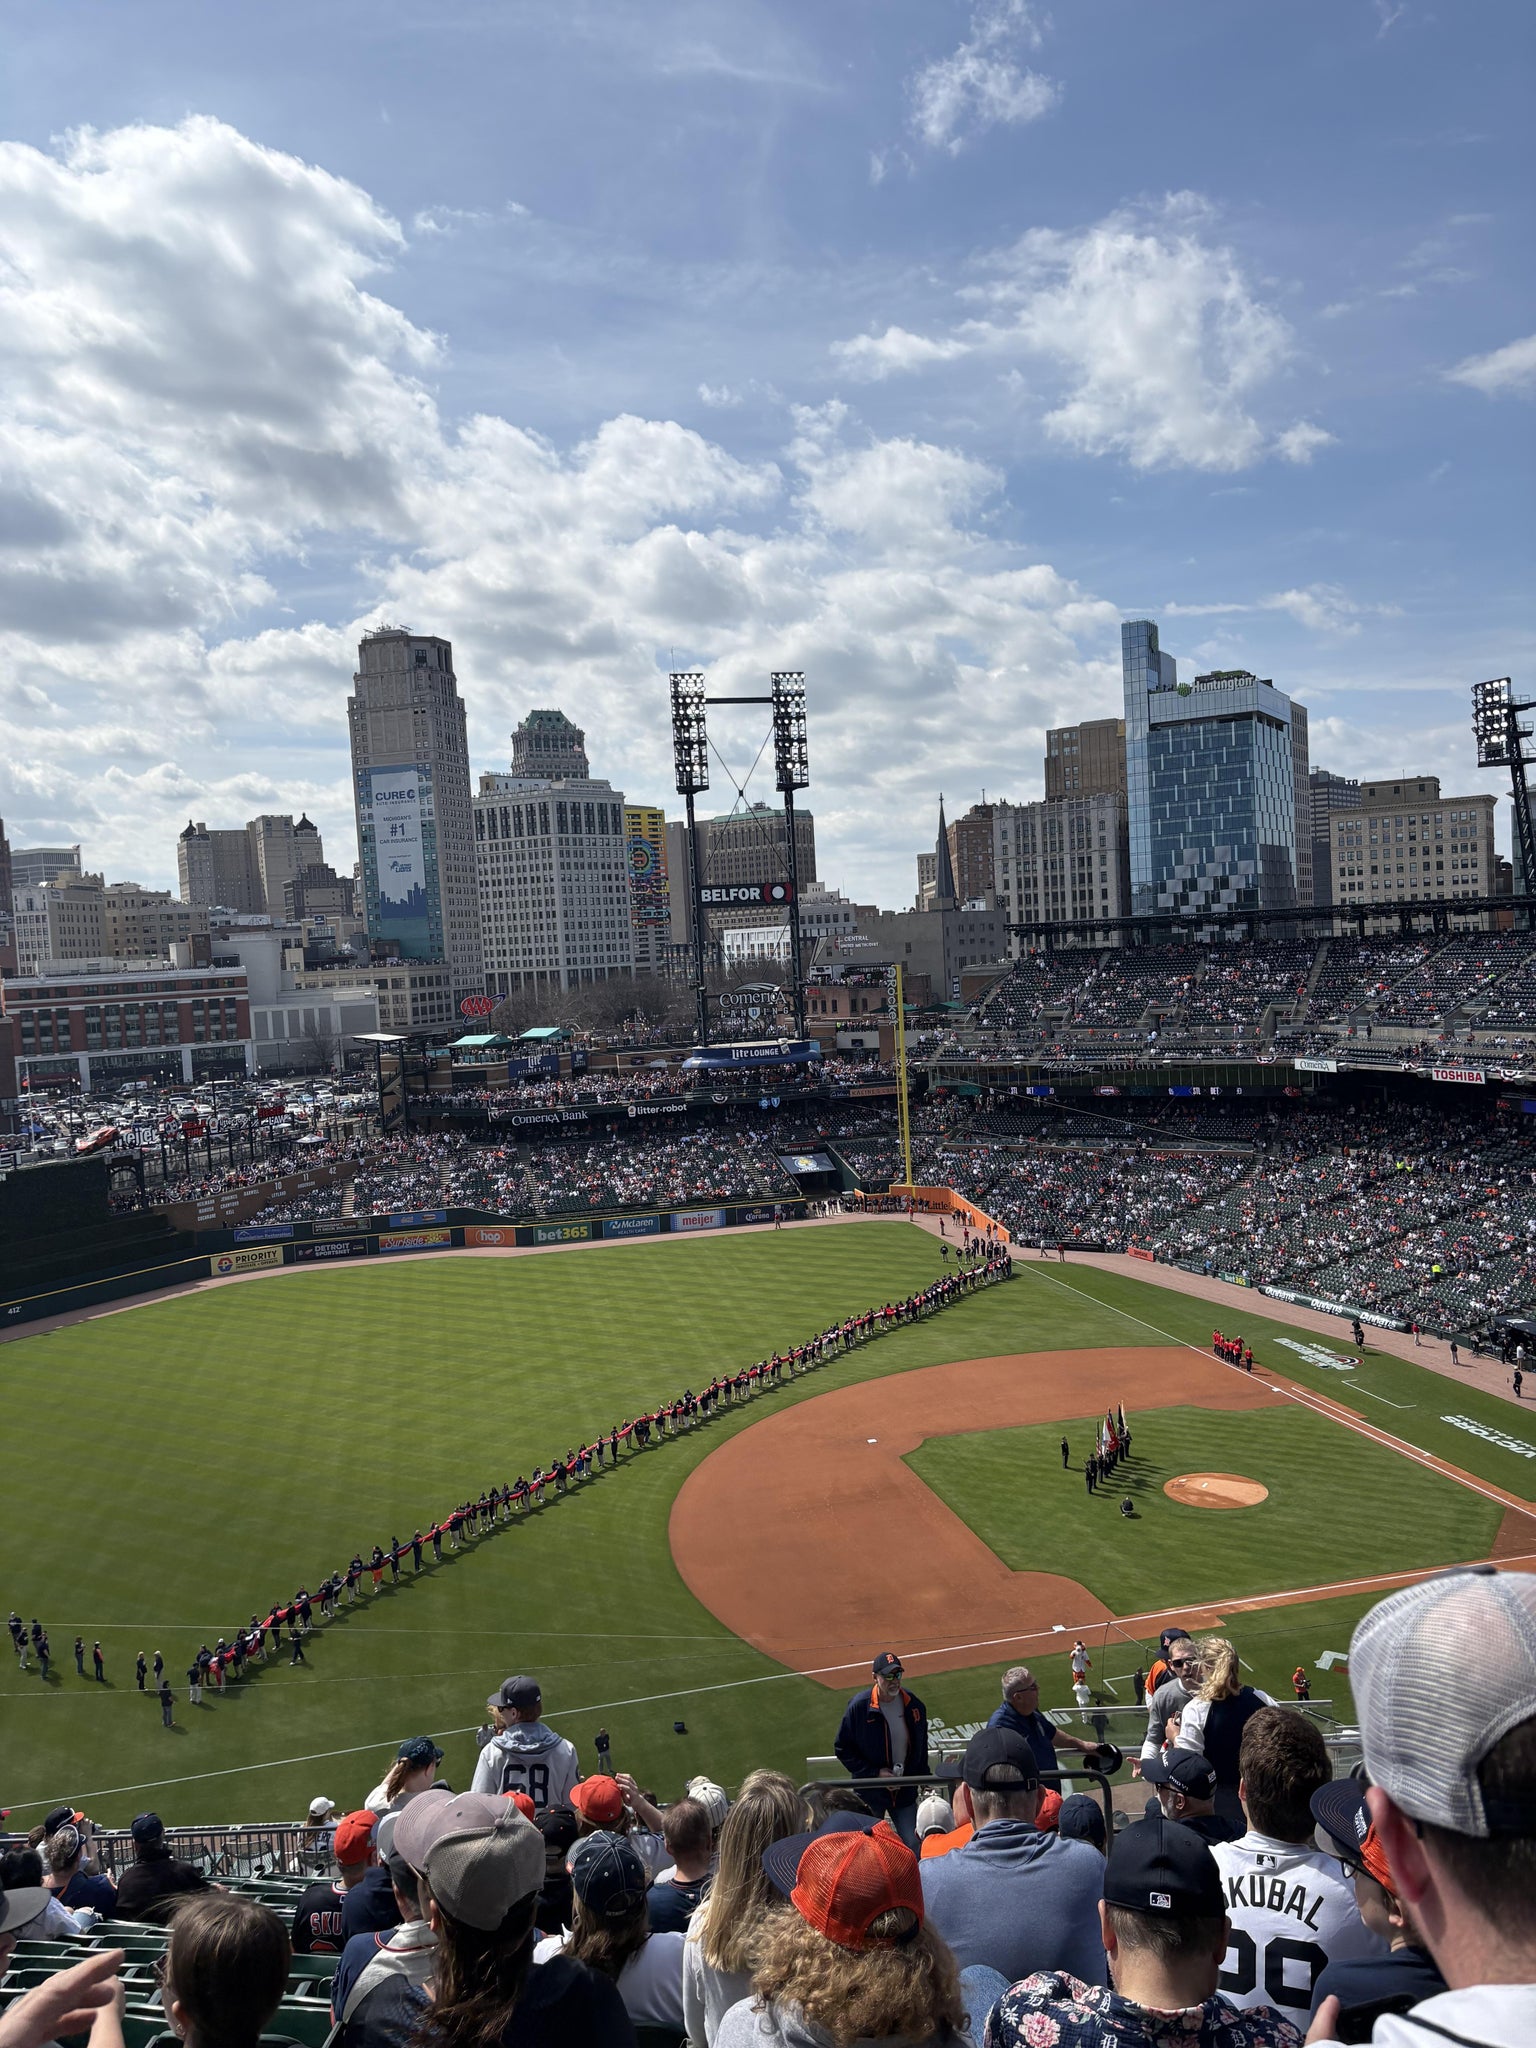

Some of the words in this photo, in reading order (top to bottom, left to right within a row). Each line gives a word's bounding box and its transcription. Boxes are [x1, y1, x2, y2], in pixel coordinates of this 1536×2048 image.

[1192, 677, 1255, 692] Huntington
[375, 790, 407, 801] CURE
[390, 822, 405, 837] #1
[701, 887, 761, 903] BELFOR
[462, 996, 491, 1015] AAA
[750, 1047, 779, 1057] LOUNGE
[1434, 1069, 1483, 1083] TOSHIBA
[562, 1110, 589, 1121] Bank
[637, 1103, 688, 1115] litter-robot
[328, 1166, 337, 1175] 42
[302, 1173, 309, 1182] 11
[275, 1181, 283, 1190] 10
[621, 1217, 654, 1229] McLaren
[682, 1212, 715, 1227] meijer
[745, 1211, 770, 1222] Corona
[480, 1230, 500, 1243] hap
[537, 1225, 588, 1242] bet365
[314, 1242, 350, 1252] DETROIT
[384, 1234, 424, 1249] Surfside
[235, 1249, 278, 1264] PRIORITY
[315, 1249, 351, 1257] SPORTSNET
[1225, 1273, 1247, 1286] bet365
[503, 1763, 550, 1808] 68
